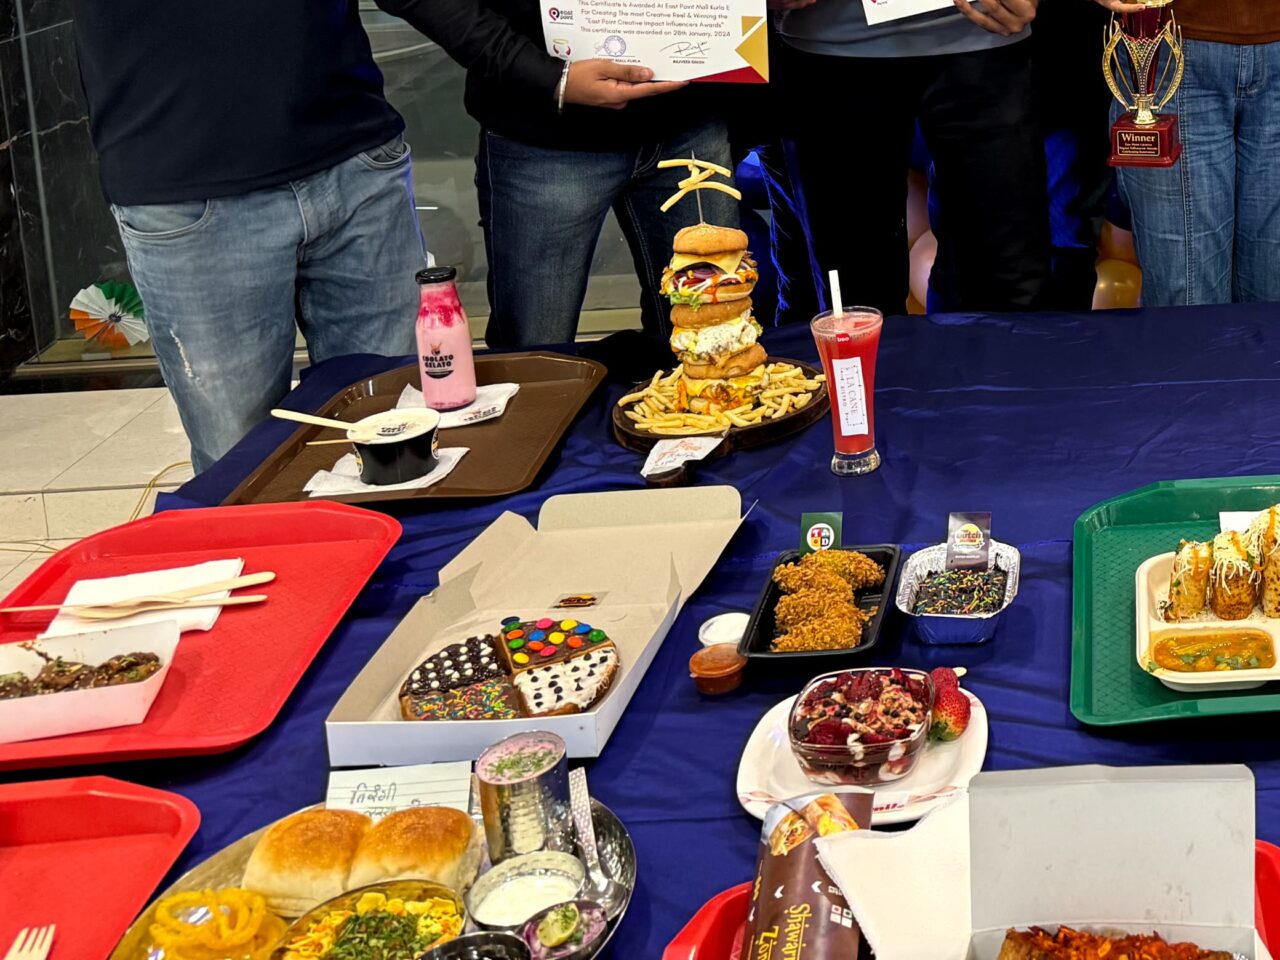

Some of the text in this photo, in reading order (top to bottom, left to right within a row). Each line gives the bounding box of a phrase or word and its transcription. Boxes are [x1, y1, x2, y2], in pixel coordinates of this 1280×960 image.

[1121, 133, 1155, 142] Winner
[422, 354, 454, 362] COOLATO
[425, 361, 452, 369] GELATO
[847, 376, 859, 415] LA CANE
[758, 926, 779, 960] Zon
